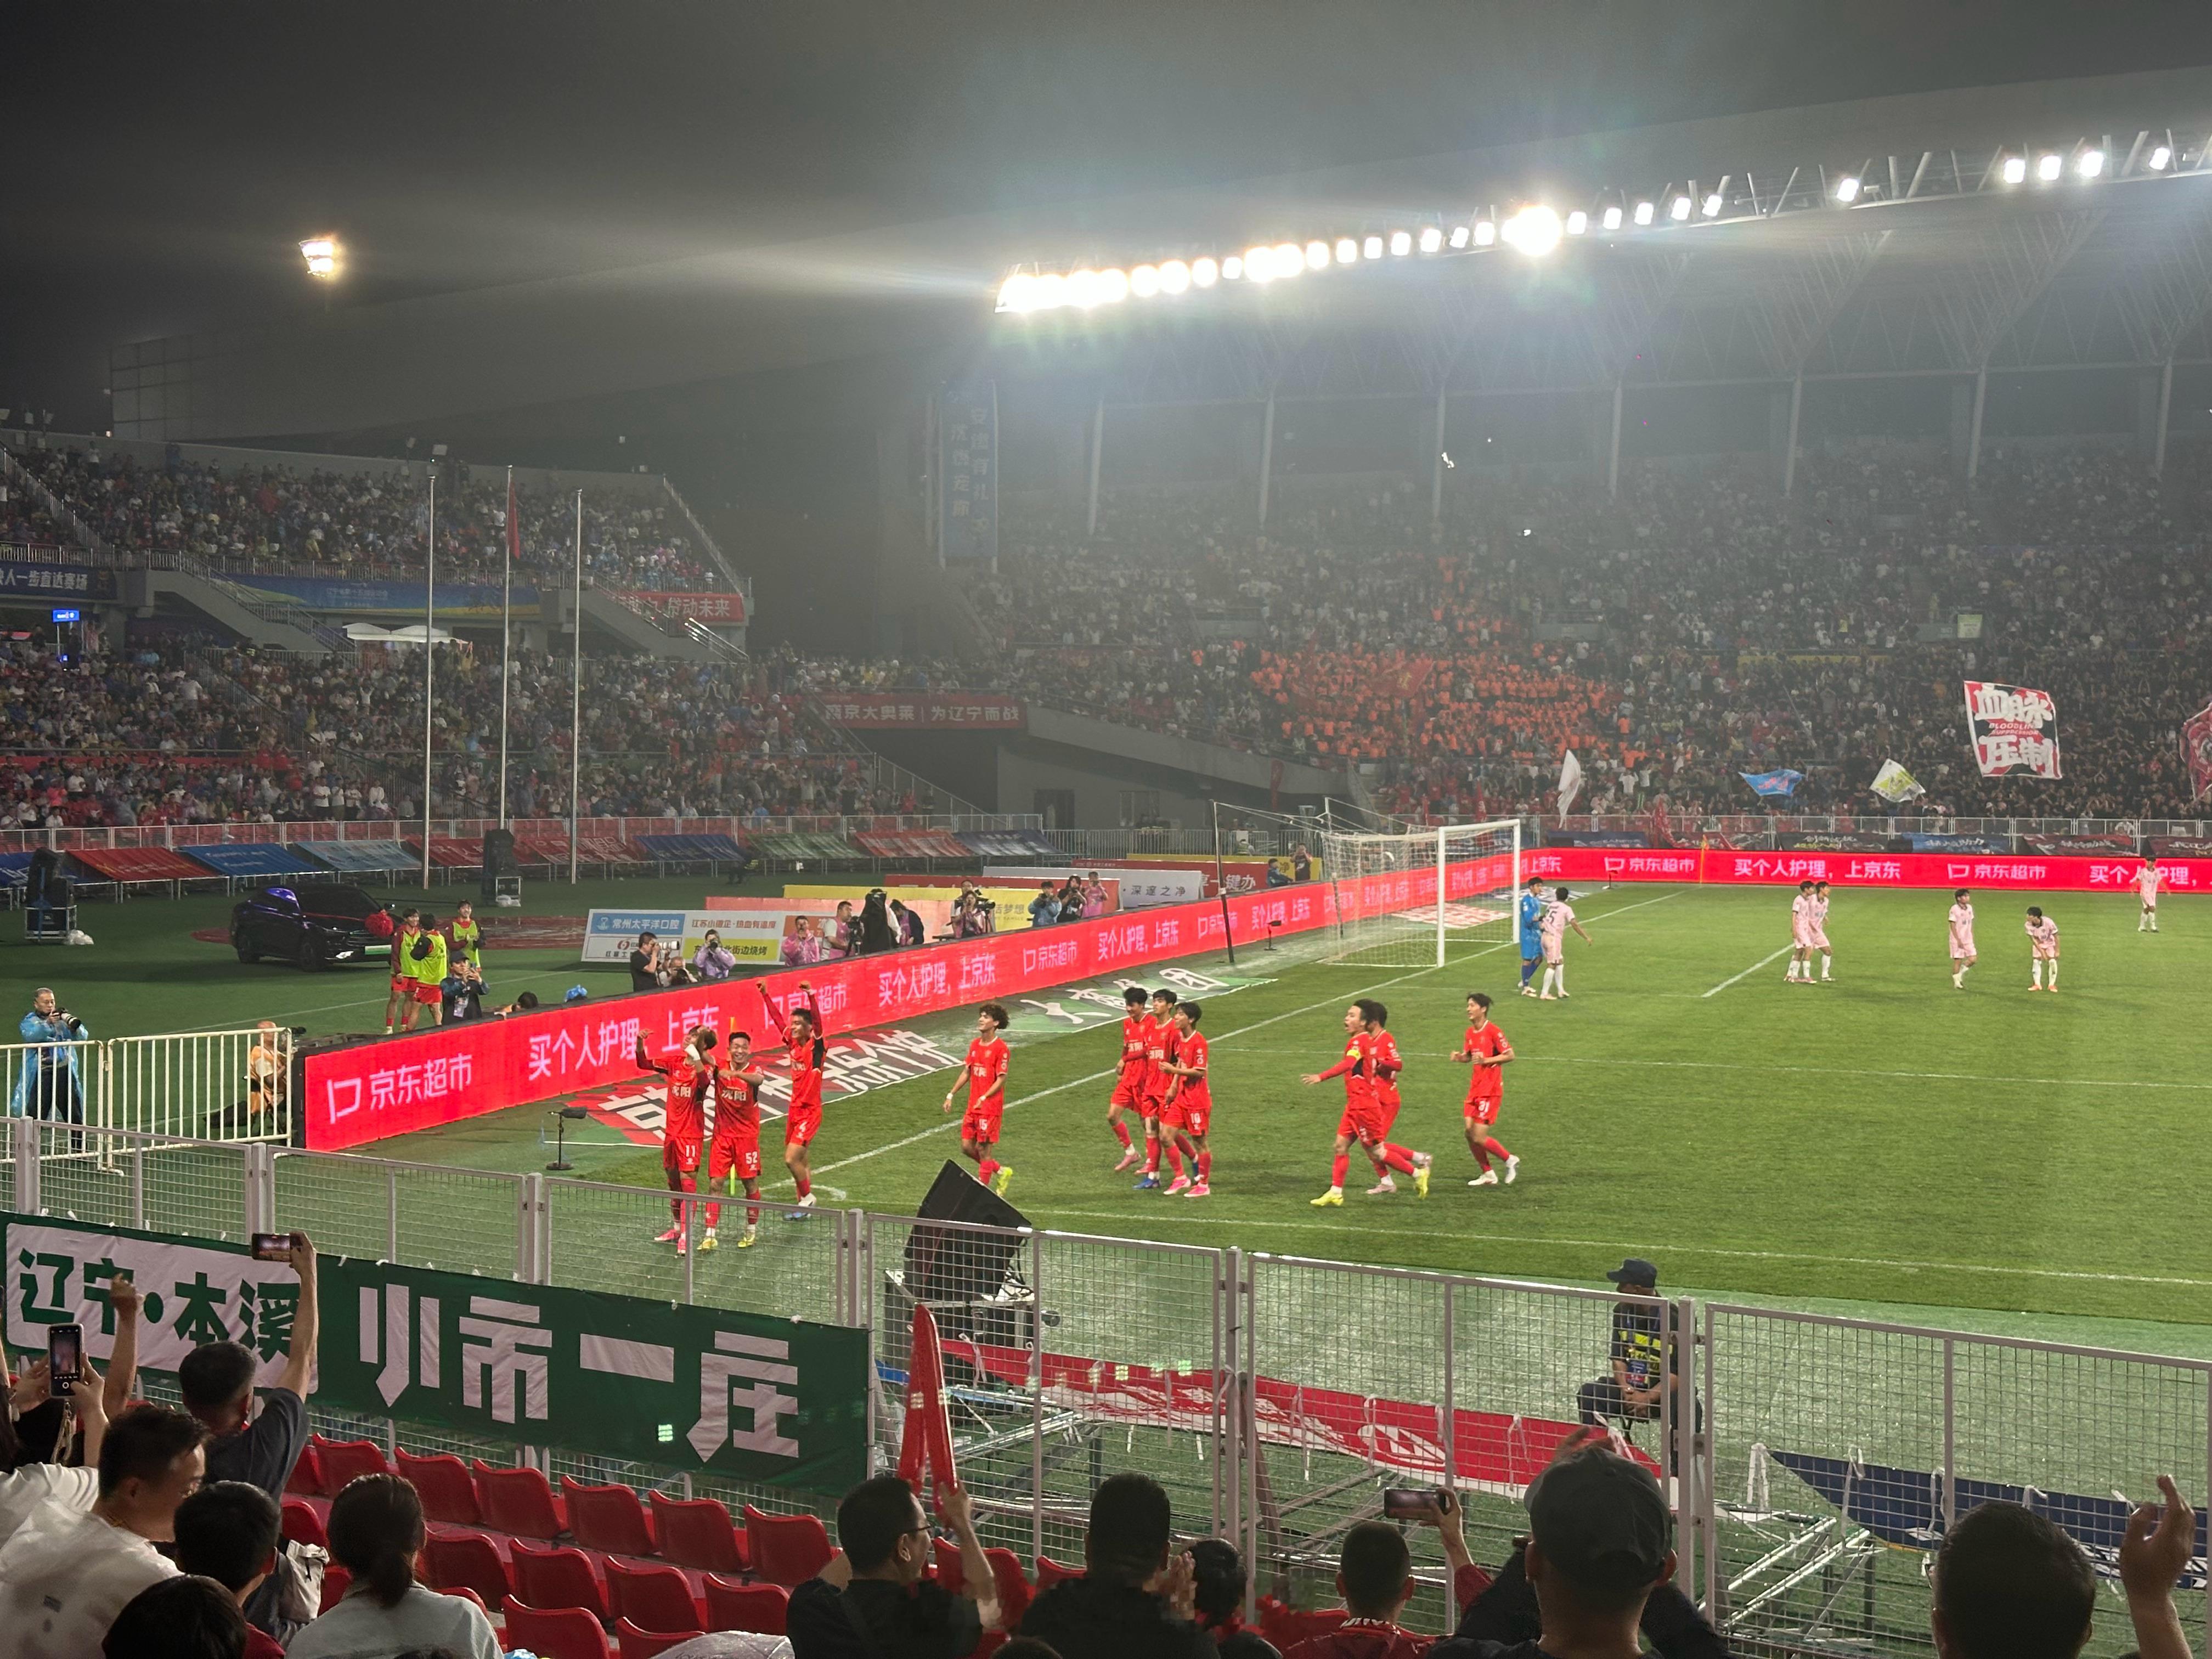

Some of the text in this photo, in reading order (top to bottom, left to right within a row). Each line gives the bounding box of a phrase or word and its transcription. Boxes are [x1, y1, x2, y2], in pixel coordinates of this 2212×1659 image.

[930, 705, 1020, 722] 为辽宁而战
[1973, 682, 2053, 729] 血脉
[1988, 722, 2036, 730] BLOODLIN
[1978, 735, 2055, 778] 压制
[1629, 857, 1695, 873] 京东超市
[1734, 859, 1901, 879] 买个人护理，上京东
[1973, 864, 2046, 881] 京东超市
[612, 918, 680, 930] 常州太平洋口腔
[1098, 920, 1179, 961] 买个人护理，上京东
[1039, 940, 1078, 969] 京东超市
[878, 953, 996, 1006] 买个人护理，上京东
[369, 1053, 472, 1110] 京东超市
[671, 1085, 692, 1099] 沈阳
[721, 1089, 747, 1102] 沈阳
[798, 1121, 807, 1133] 4
[685, 1144, 696, 1158] 11
[744, 1151, 759, 1164] 52
[359, 1283, 799, 1463] 小市一庄
